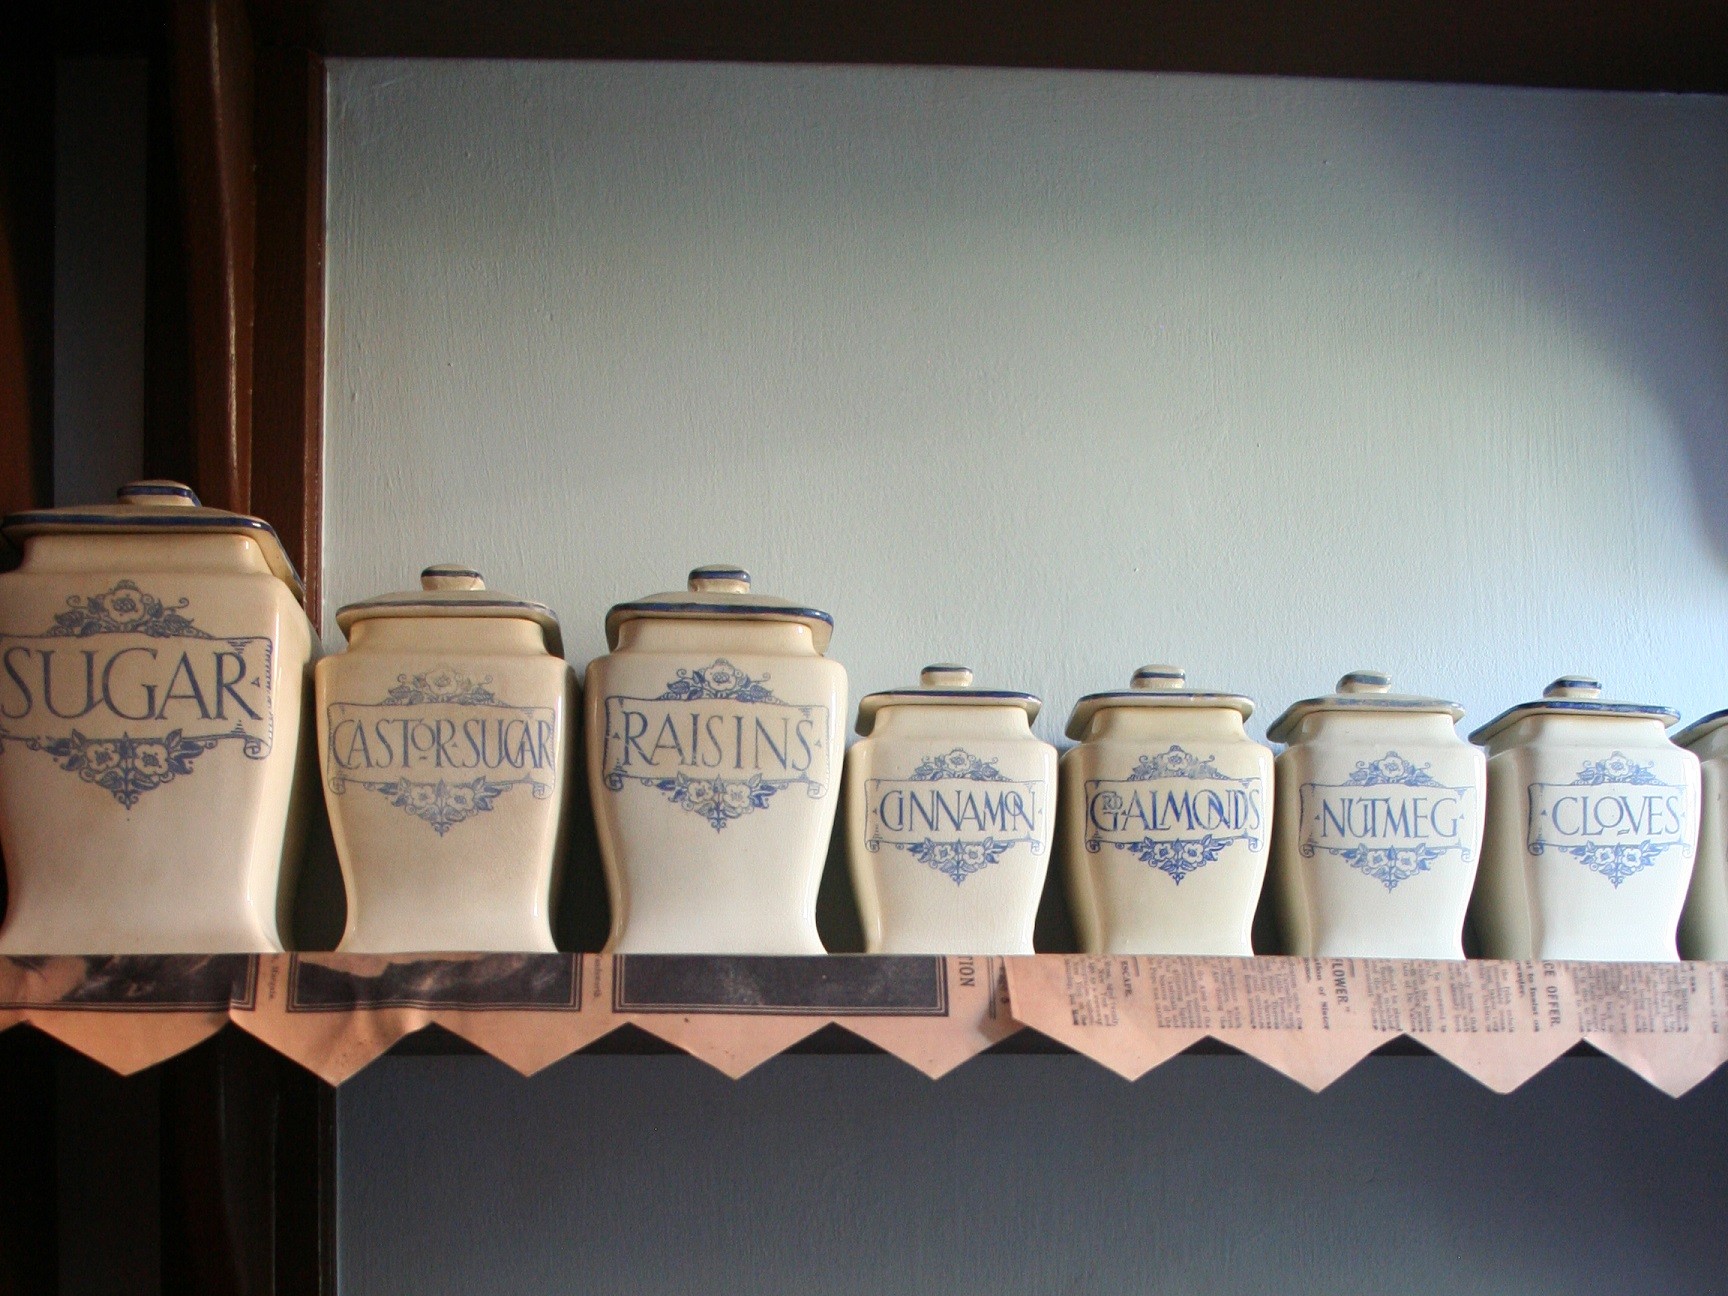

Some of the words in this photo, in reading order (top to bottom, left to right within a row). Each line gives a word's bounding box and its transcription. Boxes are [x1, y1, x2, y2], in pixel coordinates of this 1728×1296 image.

[0, 645, 262, 723] SUGAR
[463, 716, 555, 770] SUGAR
[620, 709, 815, 775] RAISINS
[879, 788, 1036, 833] CINNAMON
[1320, 793, 1459, 840] NUTMEG
[1552, 791, 1682, 837] CLOVES
[1545, 985, 1562, 1027] OFFER.
